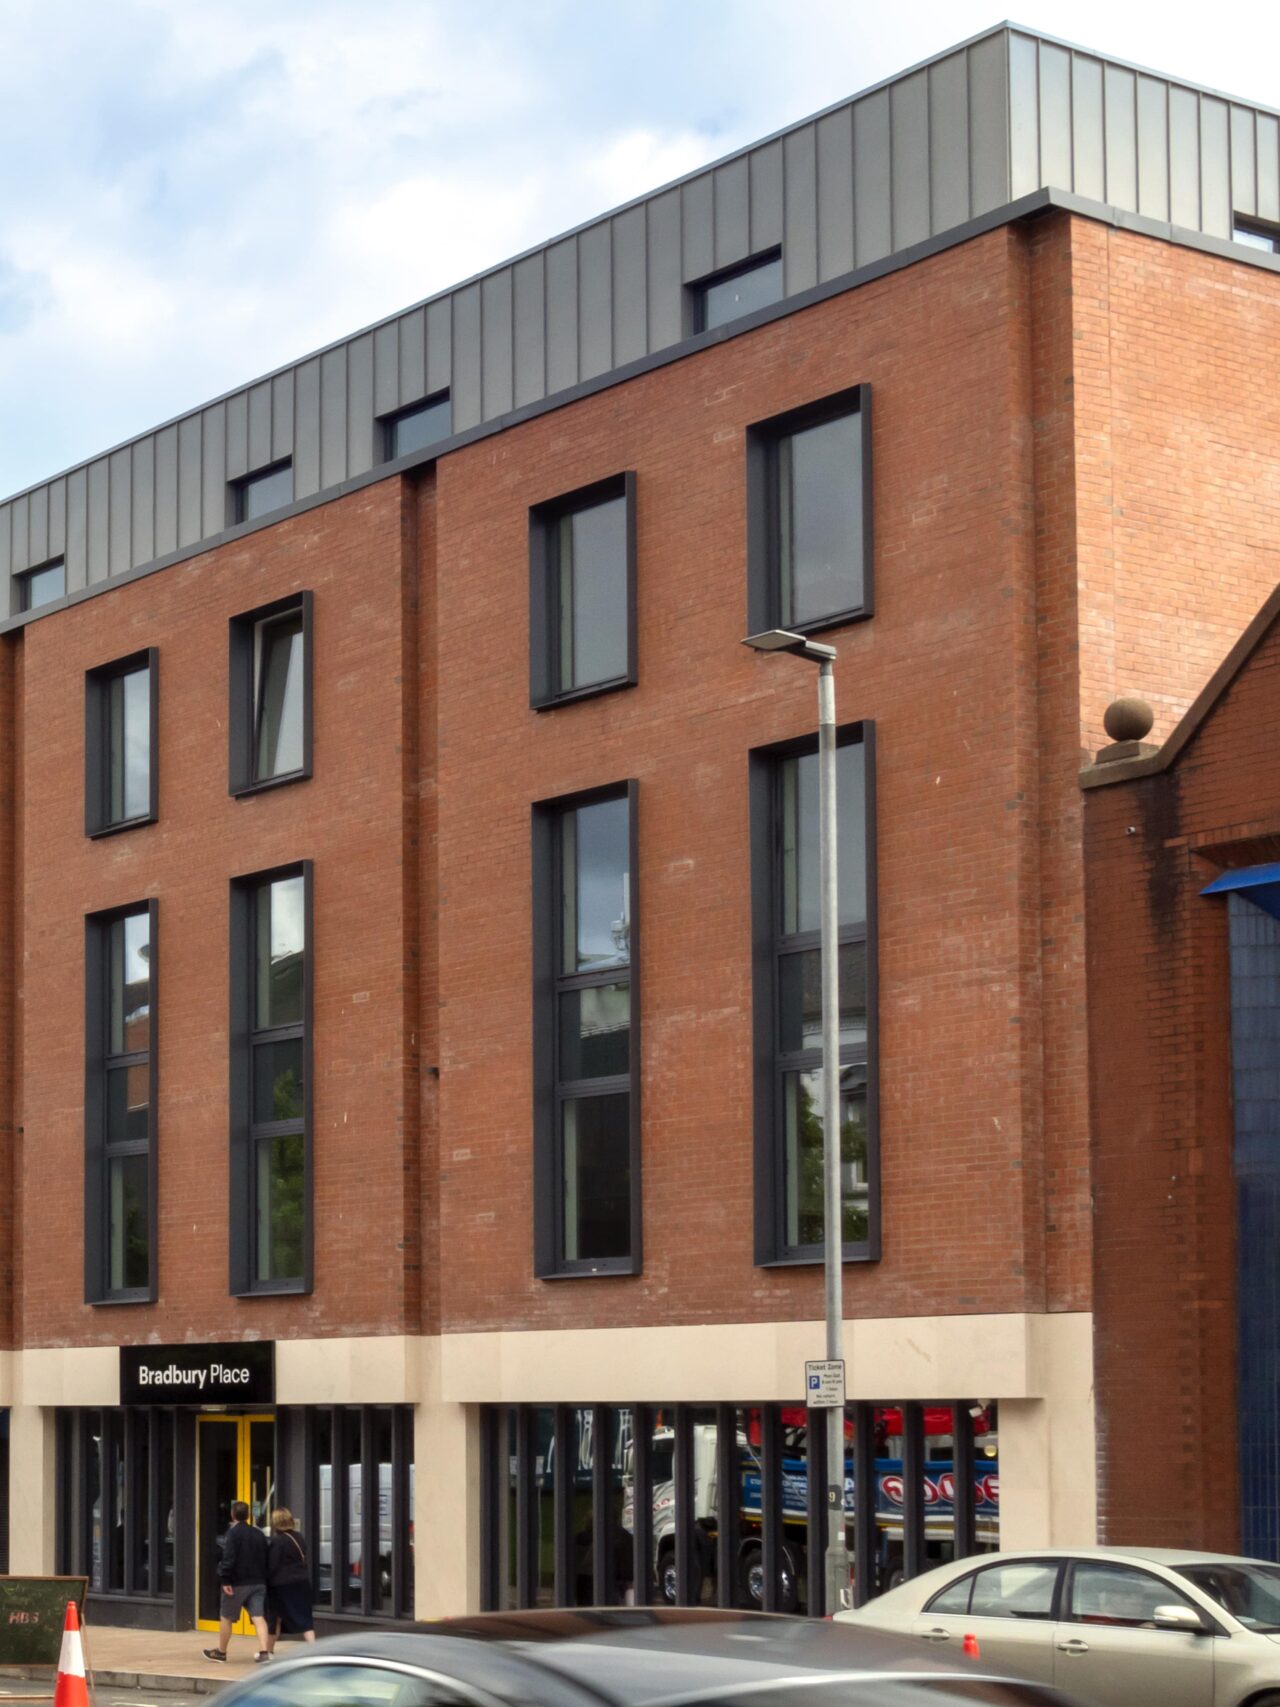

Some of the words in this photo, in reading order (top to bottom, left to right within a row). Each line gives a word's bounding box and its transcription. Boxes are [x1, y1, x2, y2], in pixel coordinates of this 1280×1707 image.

[139, 1364, 207, 1389] Bradbury
[210, 1364, 250, 1383] Place
[8, 1611, 40, 1624] HBS
